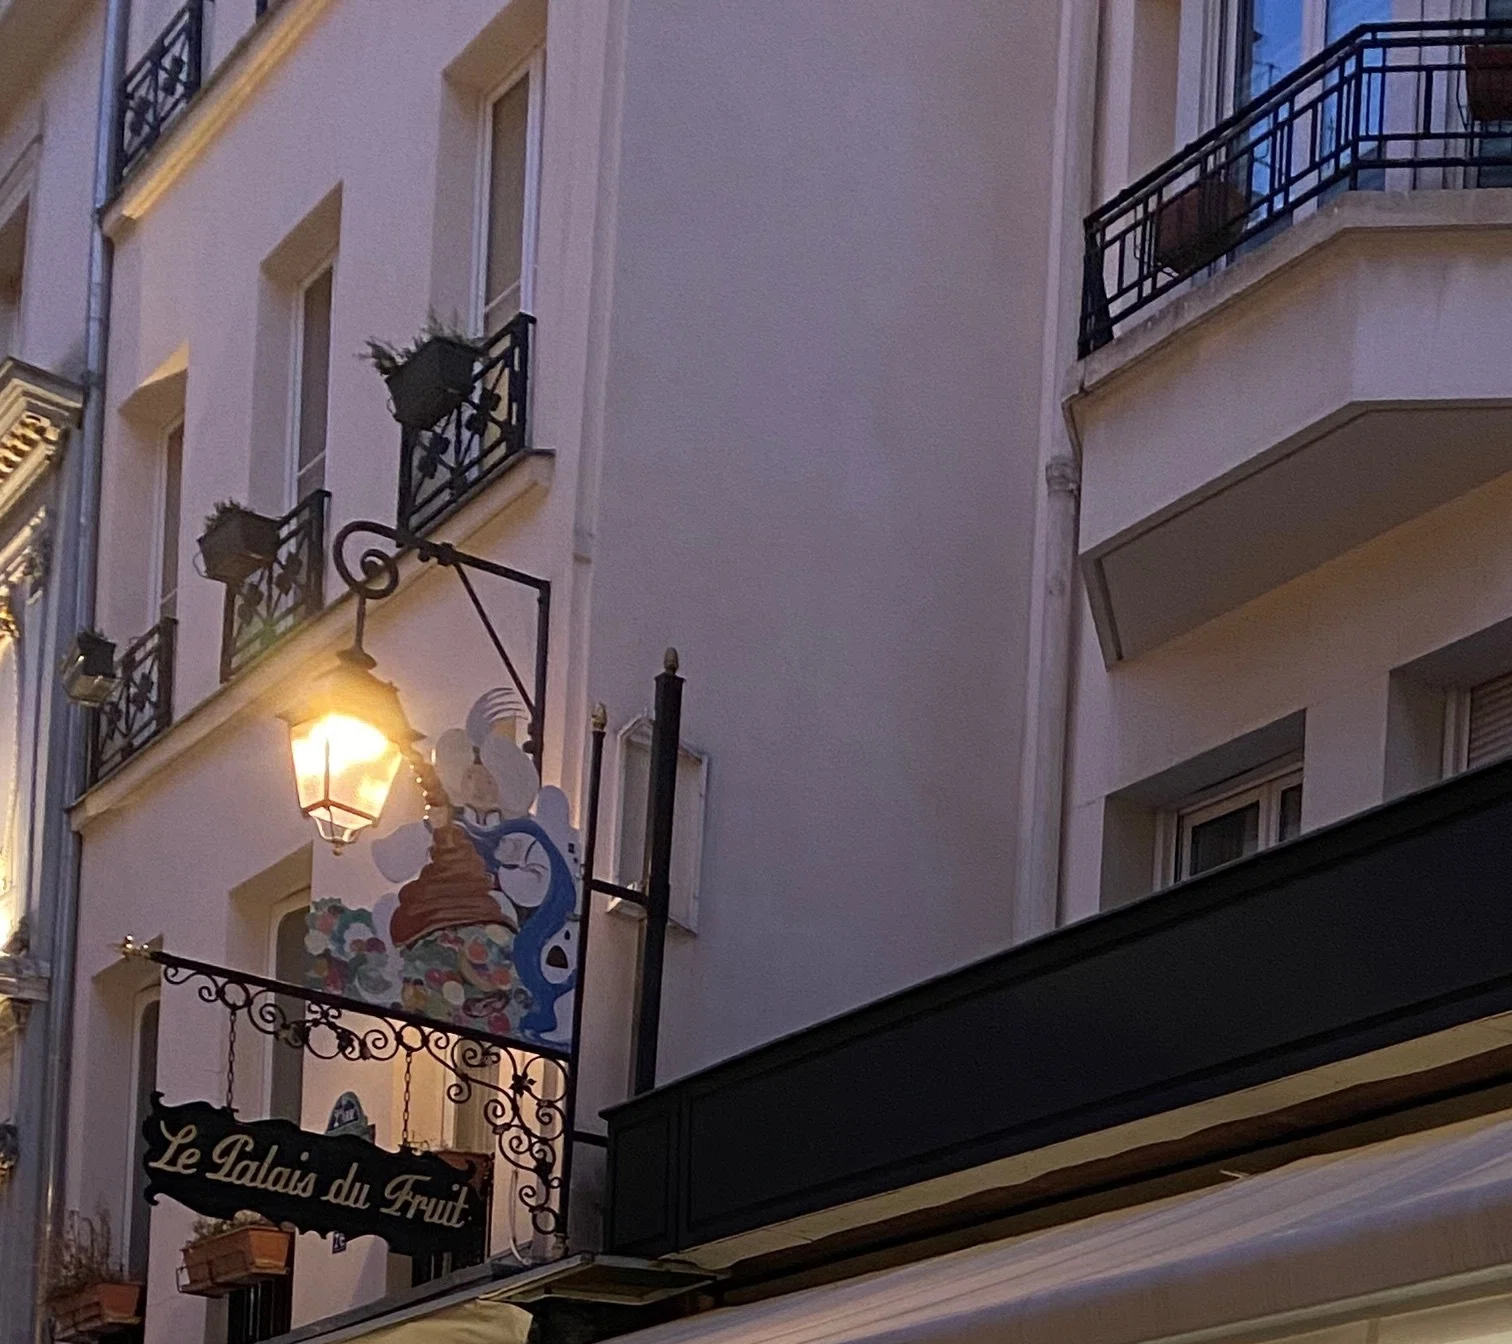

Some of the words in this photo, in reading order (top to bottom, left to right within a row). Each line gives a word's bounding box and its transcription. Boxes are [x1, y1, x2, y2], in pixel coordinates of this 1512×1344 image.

[149, 1120, 201, 1173] Le
[205, 1134, 319, 1198] Palais
[320, 1162, 372, 1210] du
[380, 1174, 471, 1228] Fruit
